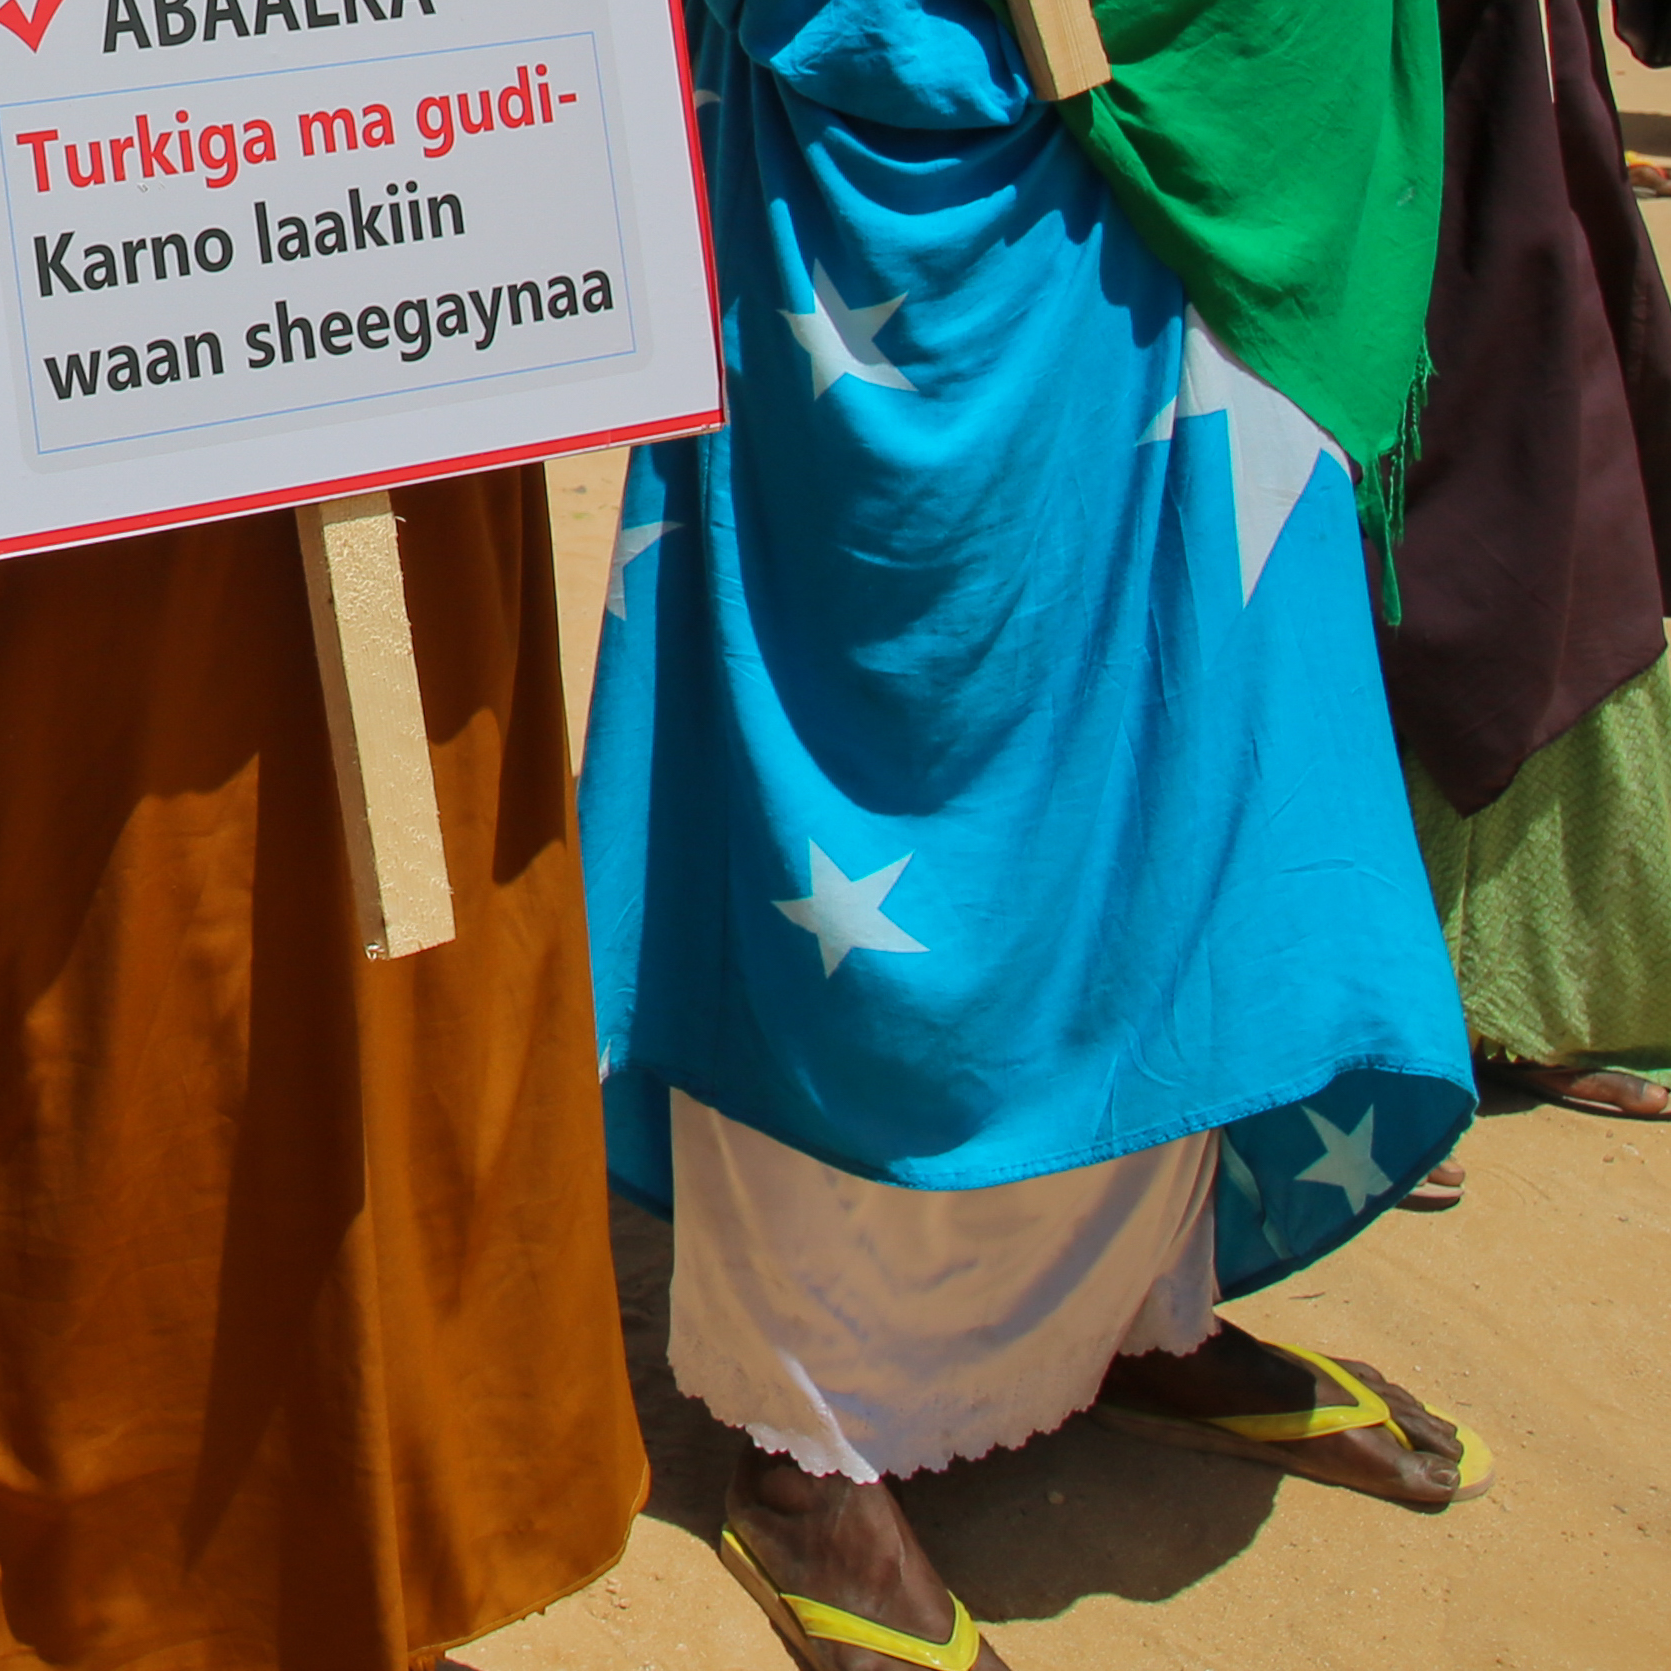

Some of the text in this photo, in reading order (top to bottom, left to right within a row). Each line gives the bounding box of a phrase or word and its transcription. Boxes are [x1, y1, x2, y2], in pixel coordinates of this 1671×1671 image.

[15, 63, 579, 192] Turkiga ma gudi-
[33, 180, 466, 297] Karno laakiin
[44, 267, 614, 399] waan sheegaynaa
